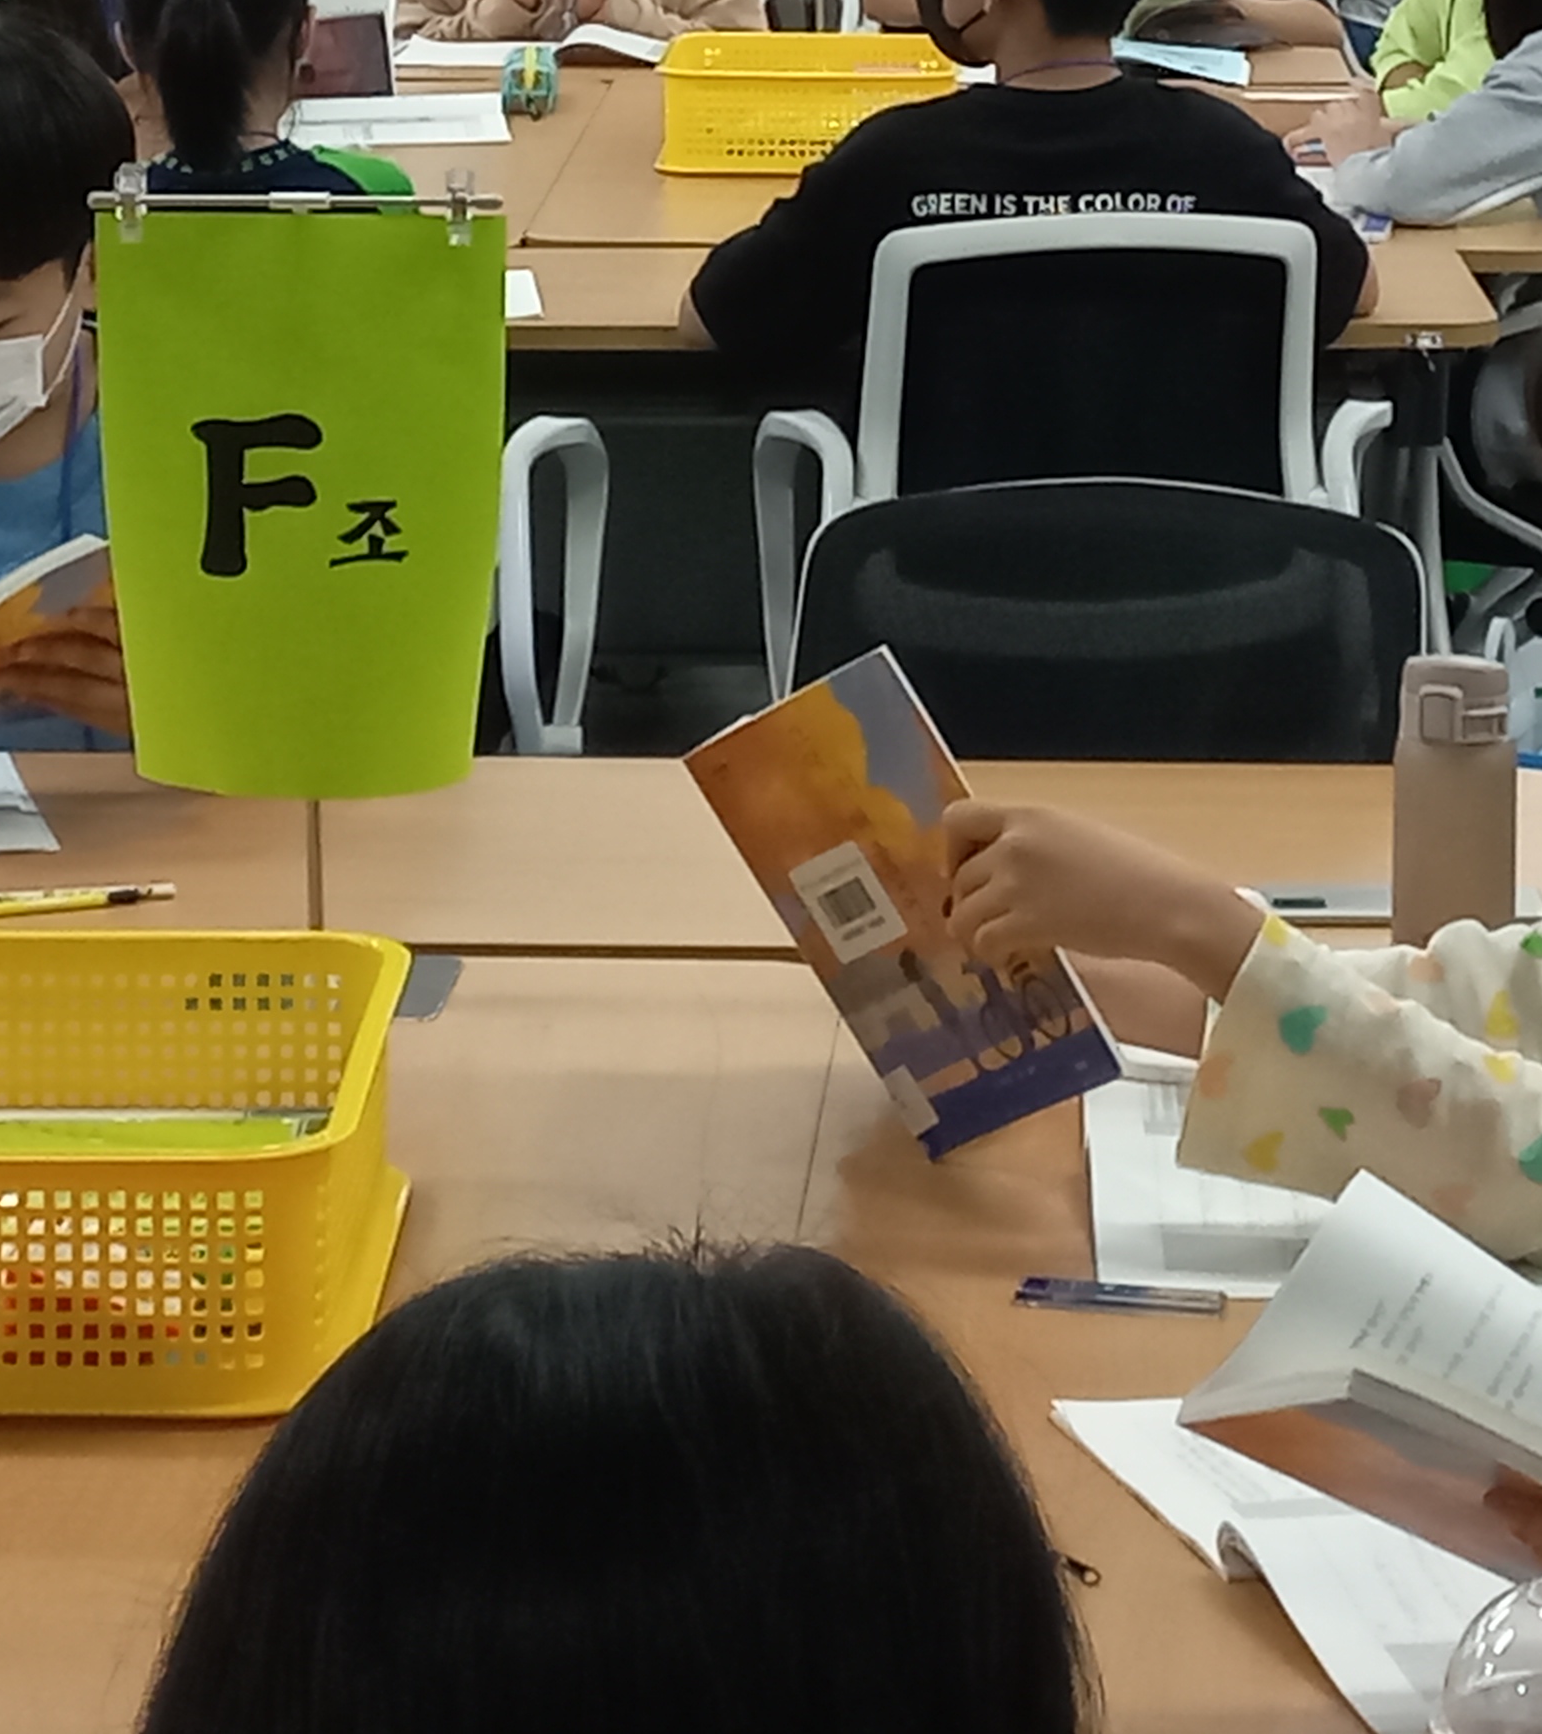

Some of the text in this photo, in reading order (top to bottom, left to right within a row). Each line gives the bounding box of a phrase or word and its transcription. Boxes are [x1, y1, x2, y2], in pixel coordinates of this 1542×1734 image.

[911, 192, 1197, 217] GREEN IS THE COLOR OF
